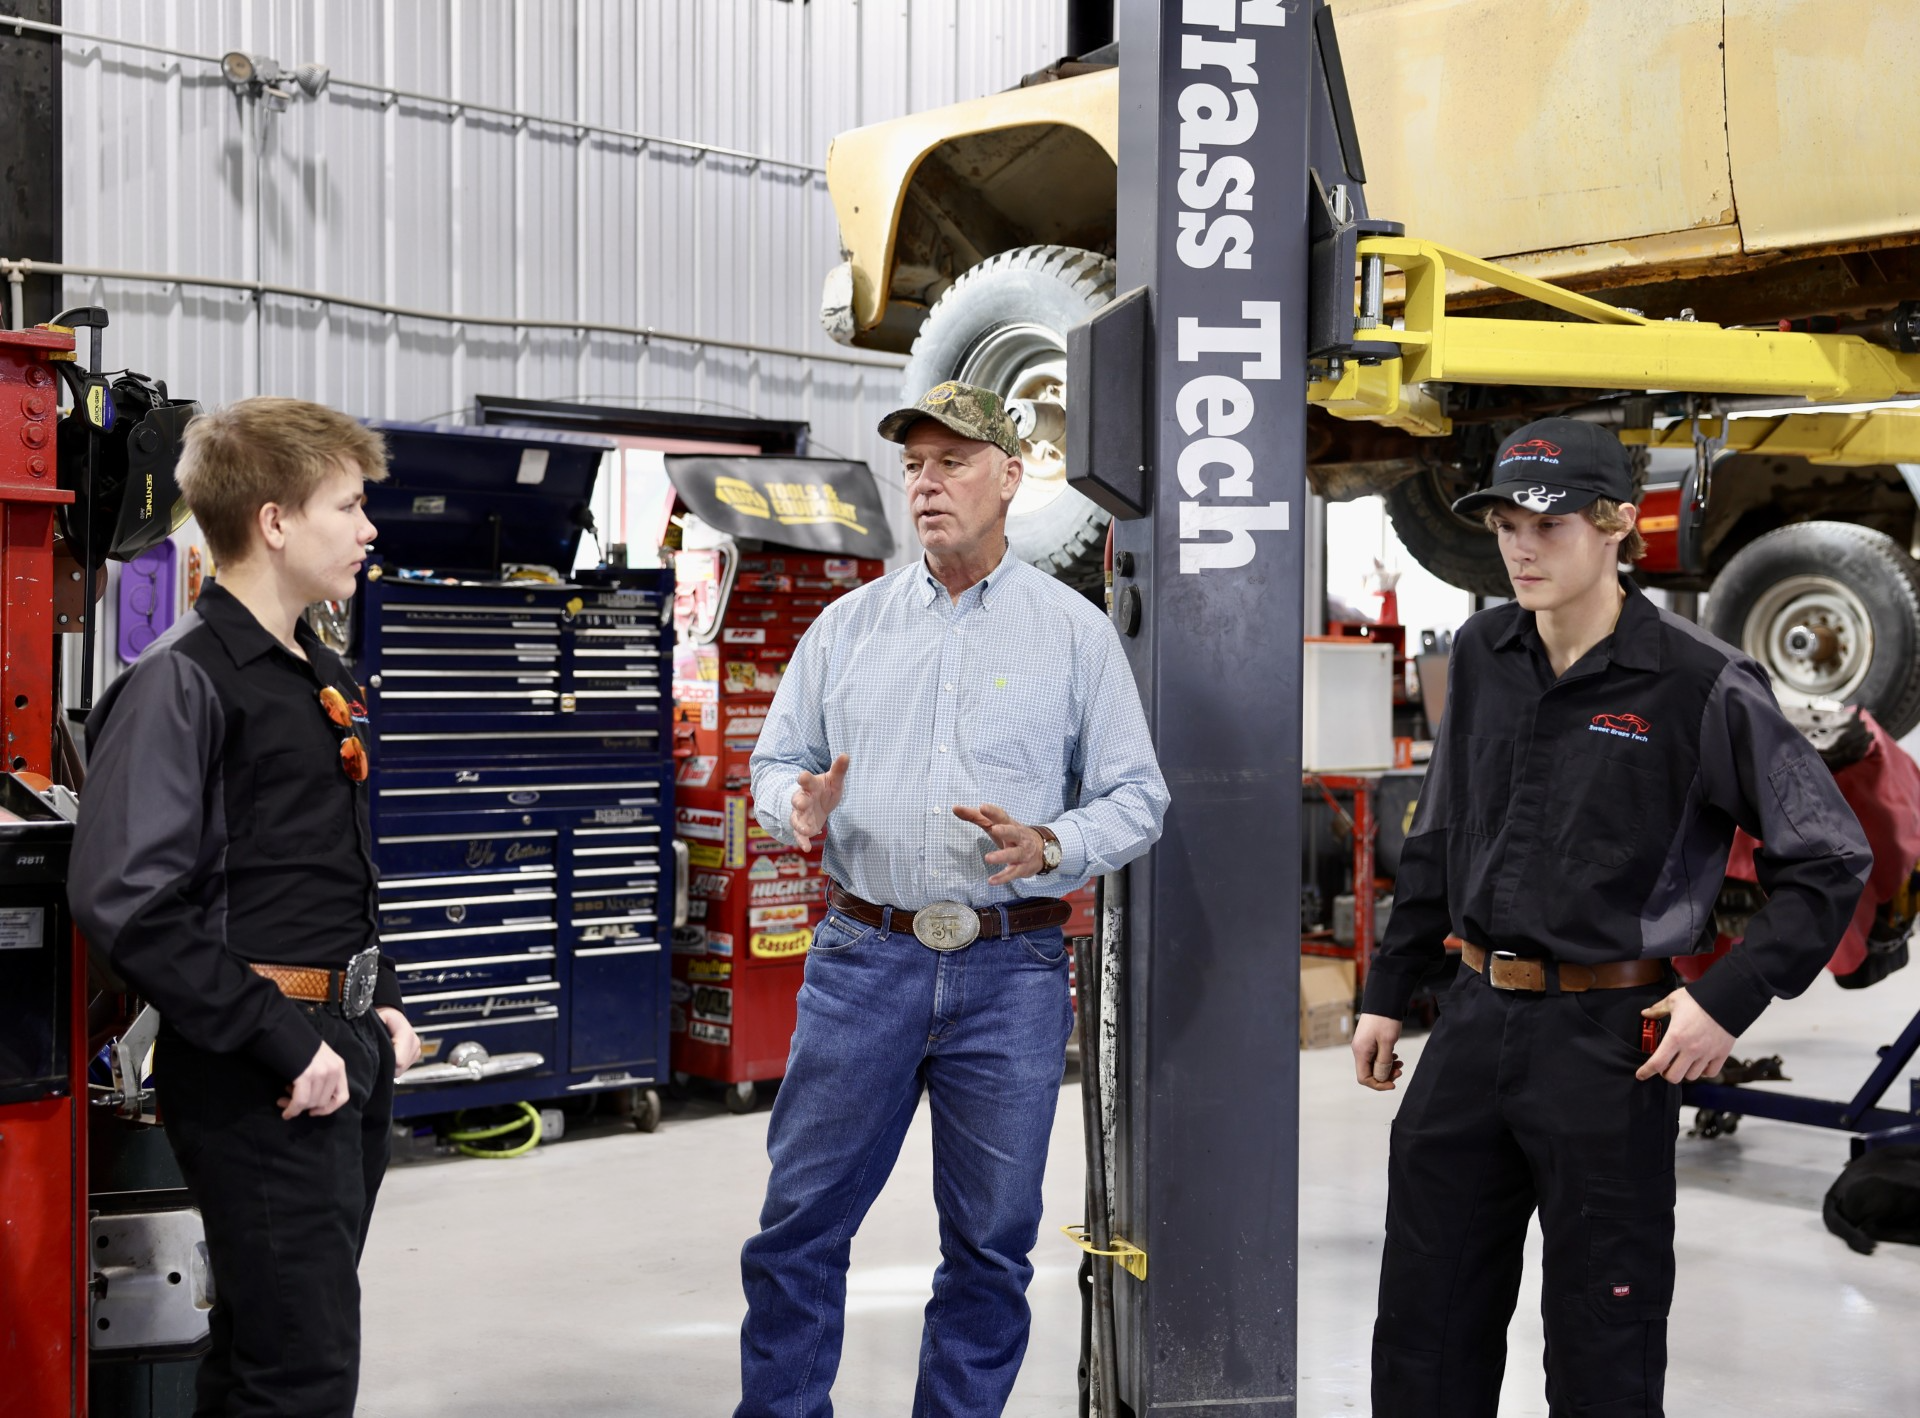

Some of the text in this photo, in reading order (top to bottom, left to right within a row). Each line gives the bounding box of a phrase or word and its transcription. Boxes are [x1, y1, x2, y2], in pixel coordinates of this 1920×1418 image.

[1176, 300, 1290, 574] Tech
[1539, 456, 1559, 465] Tech
[145, 473, 153, 519] SENTINEL
[764, 482, 820, 500] TOOLS
[771, 497, 858, 524] EQUIPMENT
[1588, 724, 1649, 742] Sweet Grass Tech
[751, 879, 821, 898] HUGHES
[584, 924, 635, 938] GMC
[757, 934, 806, 952] Bassett
